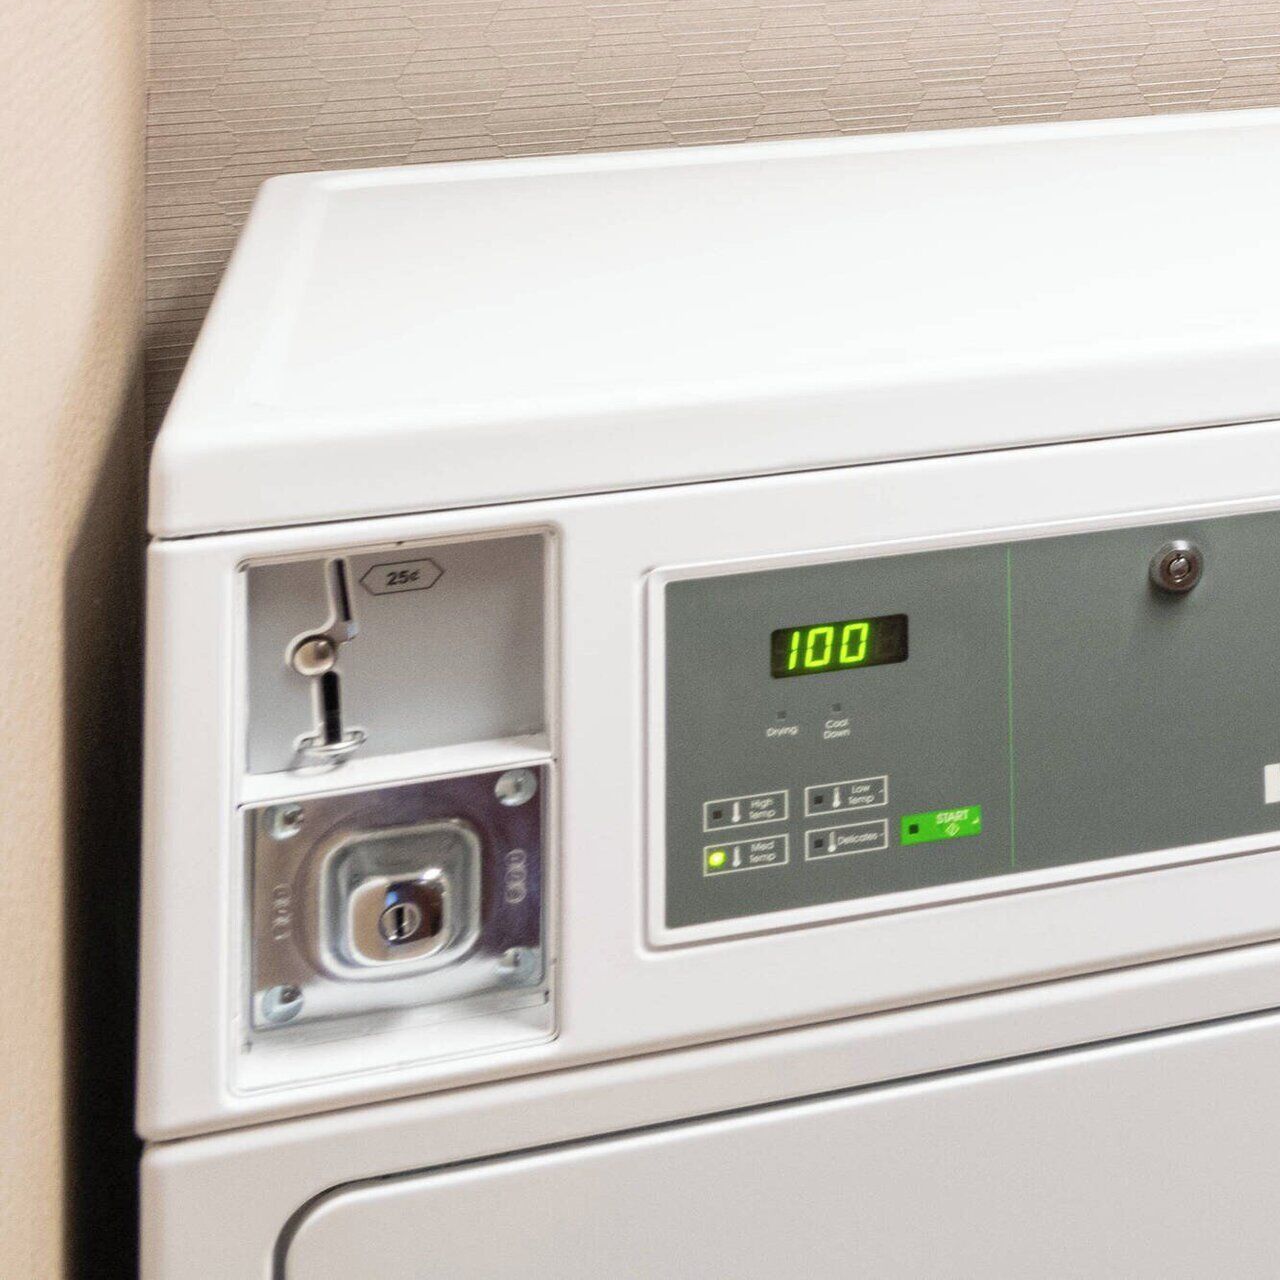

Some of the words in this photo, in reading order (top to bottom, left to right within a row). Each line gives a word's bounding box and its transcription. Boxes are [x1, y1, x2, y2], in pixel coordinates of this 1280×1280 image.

[386, 569, 420, 586] 25¢
[787, 622, 870, 671] 100
[825, 718, 849, 729] Cool
[766, 725, 799, 737] Drying
[823, 728, 851, 739] Down
[851, 784, 871, 794] Low
[751, 797, 774, 809] High
[849, 795, 875, 807] Temp
[749, 809, 776, 820] Temp
[936, 809, 970, 824] START
[838, 832, 879, 846] Delicates
[751, 841, 775, 852] Med
[749, 853, 776, 864] Temp
